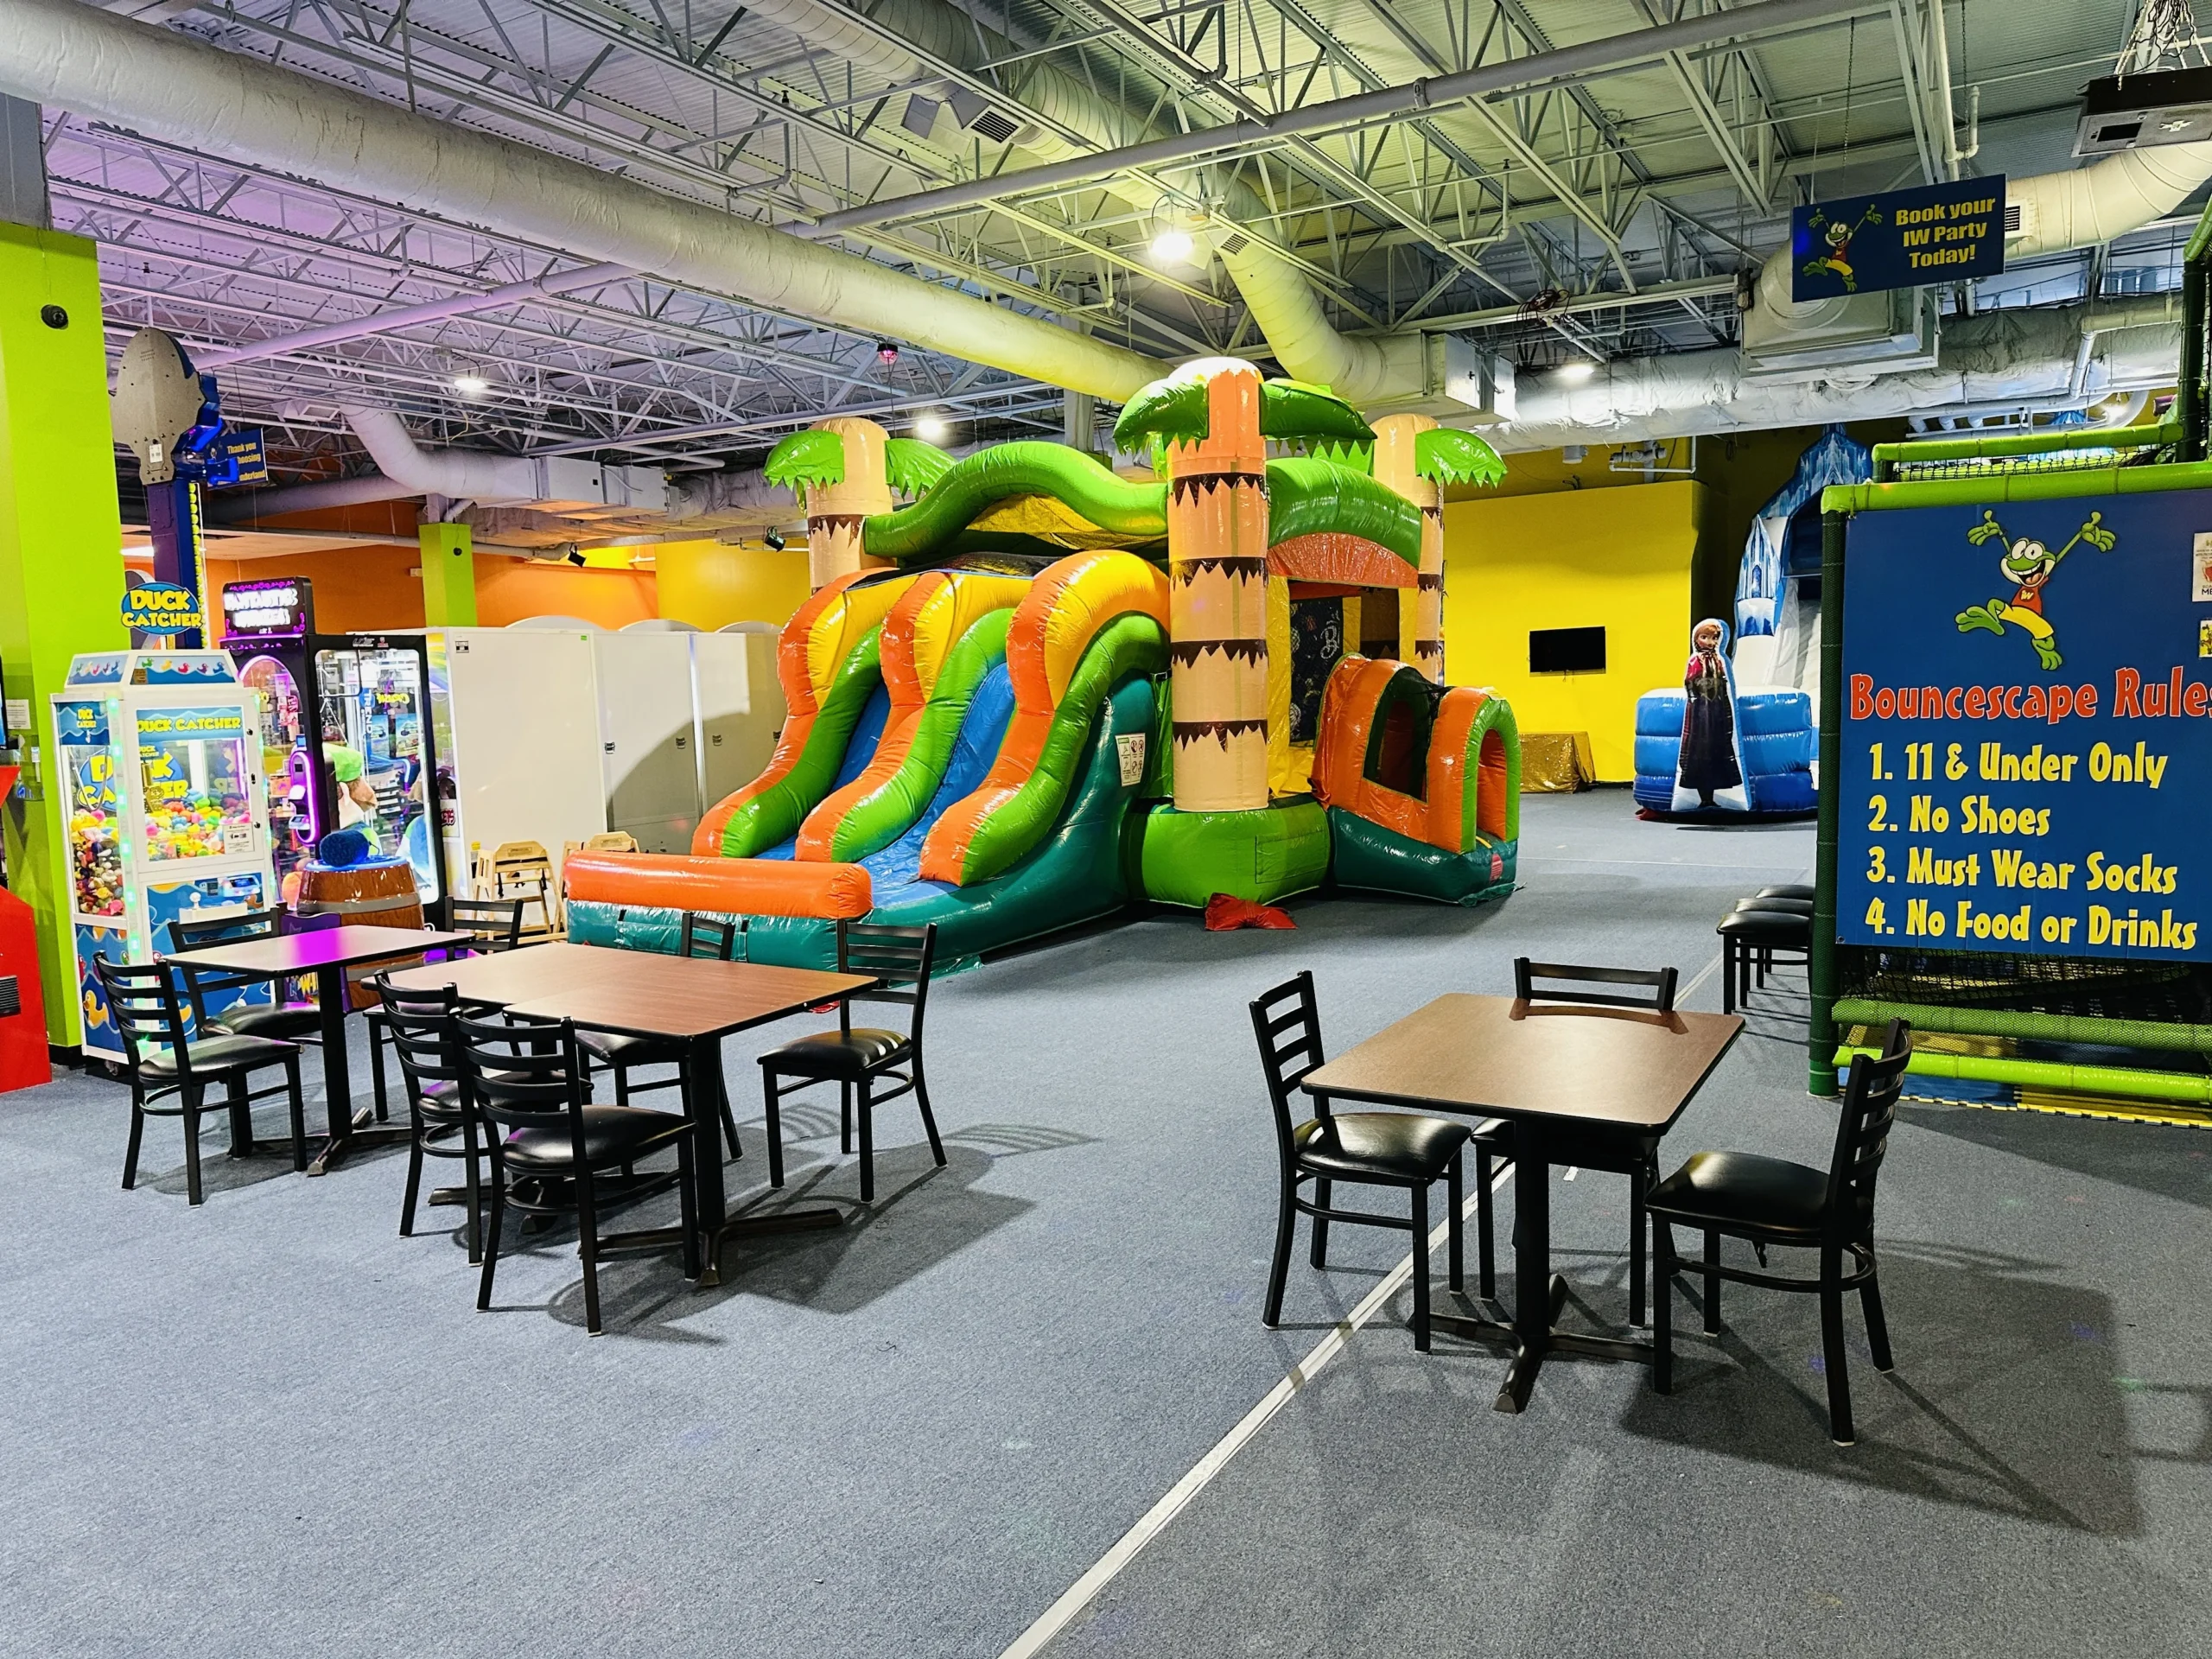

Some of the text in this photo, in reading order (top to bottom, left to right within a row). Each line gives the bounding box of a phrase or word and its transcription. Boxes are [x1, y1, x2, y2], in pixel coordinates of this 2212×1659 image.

[1896, 198, 1994, 226] Book your
[1903, 222, 1987, 246] IW Party
[1909, 244, 1976, 269] Today!
[237, 453, 261, 464] hoosing
[245, 442, 257, 452] you
[238, 469, 266, 481] nderland
[130, 588, 192, 611] DUCK
[121, 611, 203, 629] CATCHER
[1851, 665, 2212, 723] Bouncescape Rule
[137, 716, 242, 733] DUCK CATCHER
[1871, 742, 2166, 788] 1. 11 & Under Only
[1869, 795, 2050, 836] 2. No Shoes
[1867, 847, 2177, 893] 3. Must Wear Socks
[1866, 899, 2196, 950] 4. No Food or Drinks
